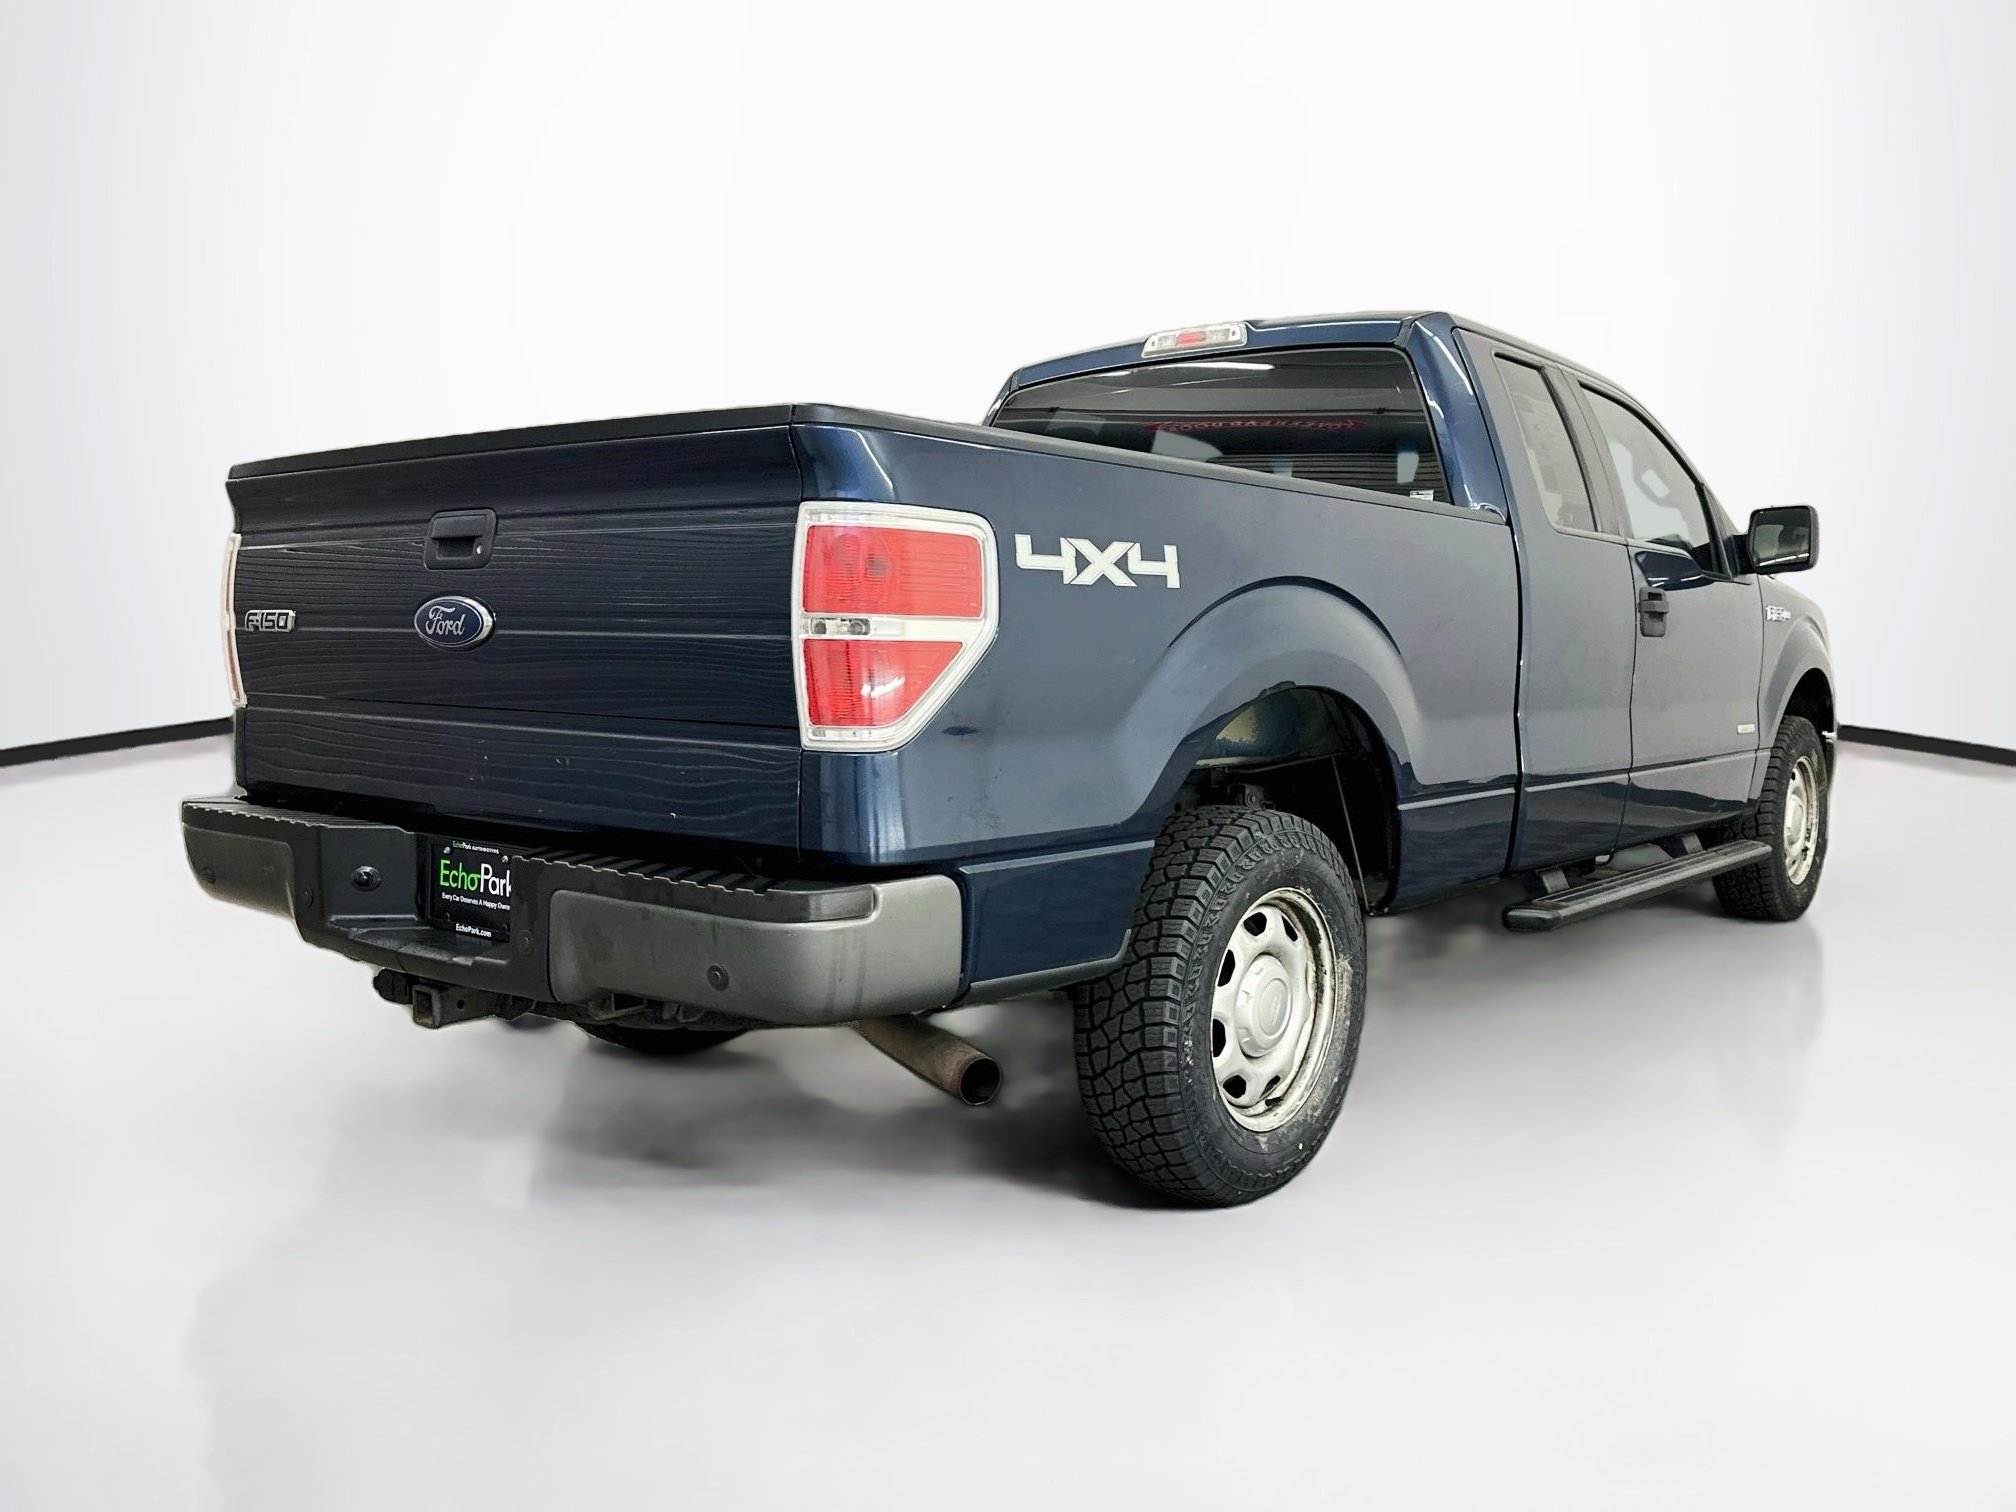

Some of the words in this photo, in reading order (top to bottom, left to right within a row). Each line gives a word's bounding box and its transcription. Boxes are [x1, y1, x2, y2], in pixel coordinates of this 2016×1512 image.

[425, 605, 466, 636] Ford
[440, 859, 512, 898] EchoPark
[441, 892, 452, 902] Every
[452, 894, 460, 902] Car
[482, 899, 497, 910] Happy
[455, 923, 491, 937] EchoPark.com
